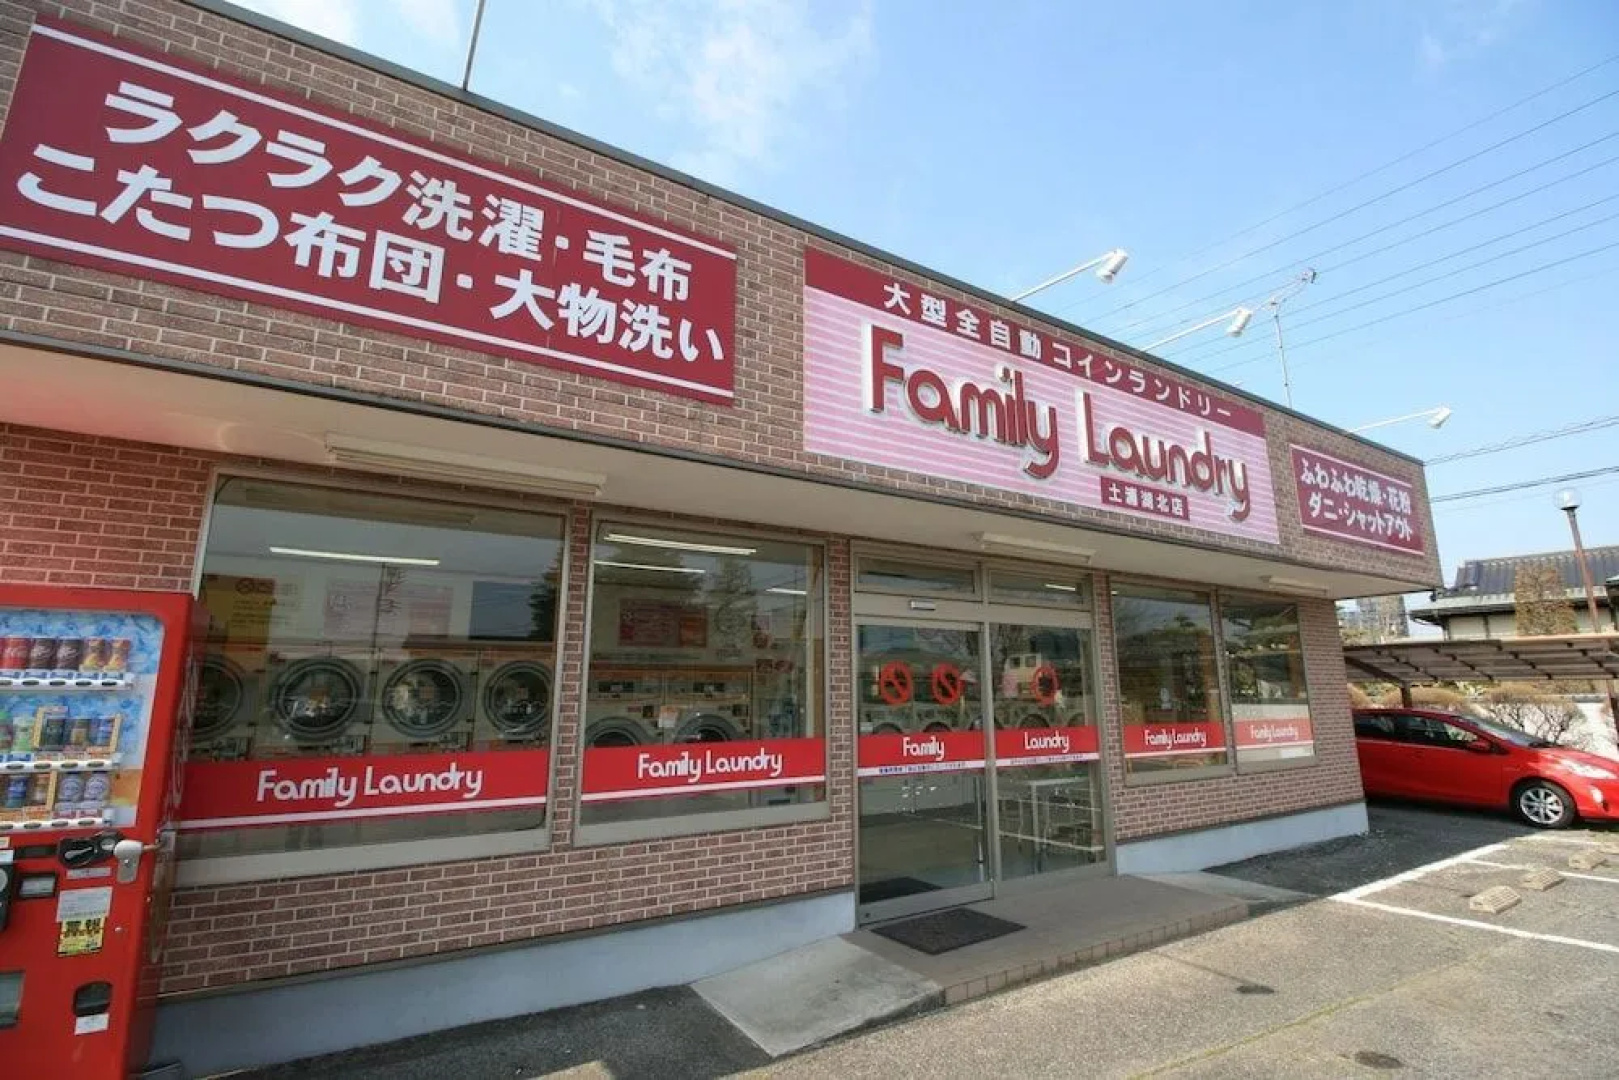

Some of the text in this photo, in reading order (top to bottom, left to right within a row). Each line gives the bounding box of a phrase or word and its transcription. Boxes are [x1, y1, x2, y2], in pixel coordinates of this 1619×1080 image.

[105, 81, 692, 303] ラクラク洗濯・毛布
[18, 143, 725, 362] こたつ布団・大物洗い
[866, 323, 1250, 521] Family Laundry
[903, 730, 1069, 761] Family Laundry
[1144, 726, 1206, 749] Family Laundry
[256, 762, 483, 808] Family Laundry
[637, 747, 783, 783] Family Laundry
